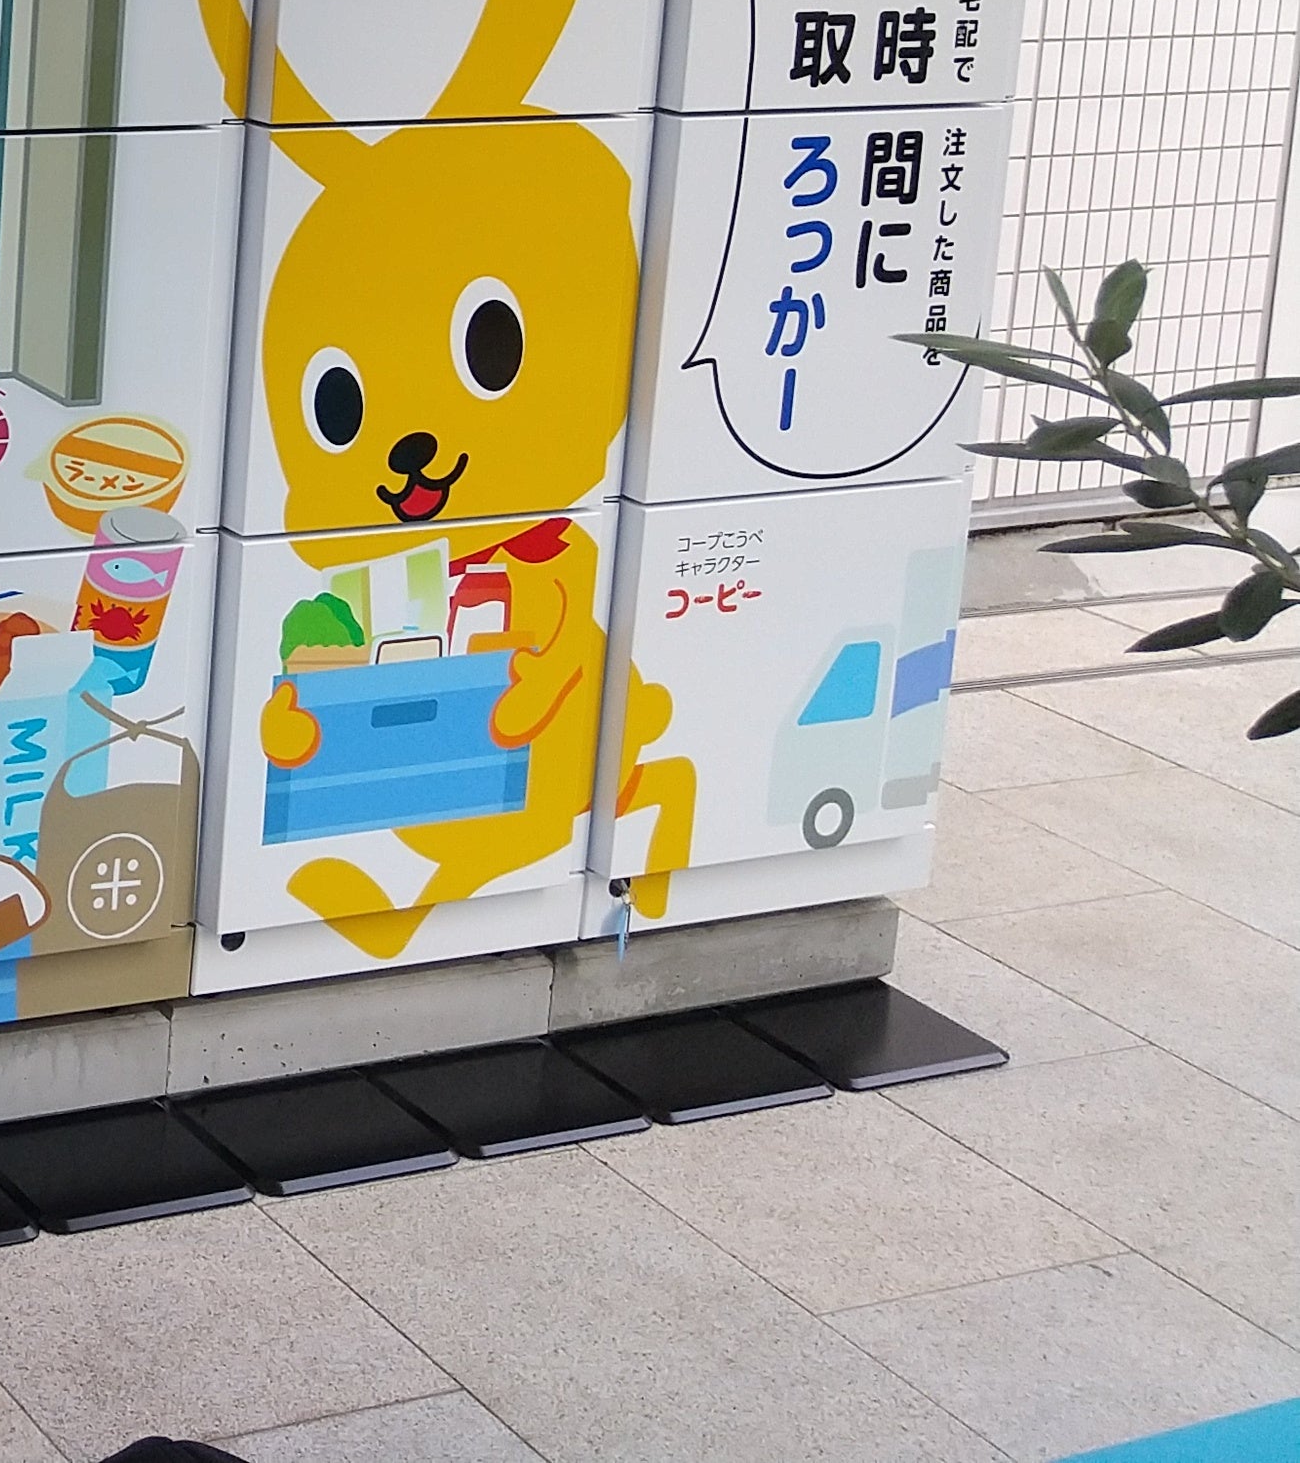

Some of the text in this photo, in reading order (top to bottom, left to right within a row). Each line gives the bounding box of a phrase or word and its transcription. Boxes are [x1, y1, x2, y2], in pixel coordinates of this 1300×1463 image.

[63, 459, 145, 493] ラーメン
[677, 529, 764, 553] コープこうべ
[675, 555, 761, 577] キャラクター
[665, 580, 762, 619] コーピー
[1, 717, 48, 861] MILK
